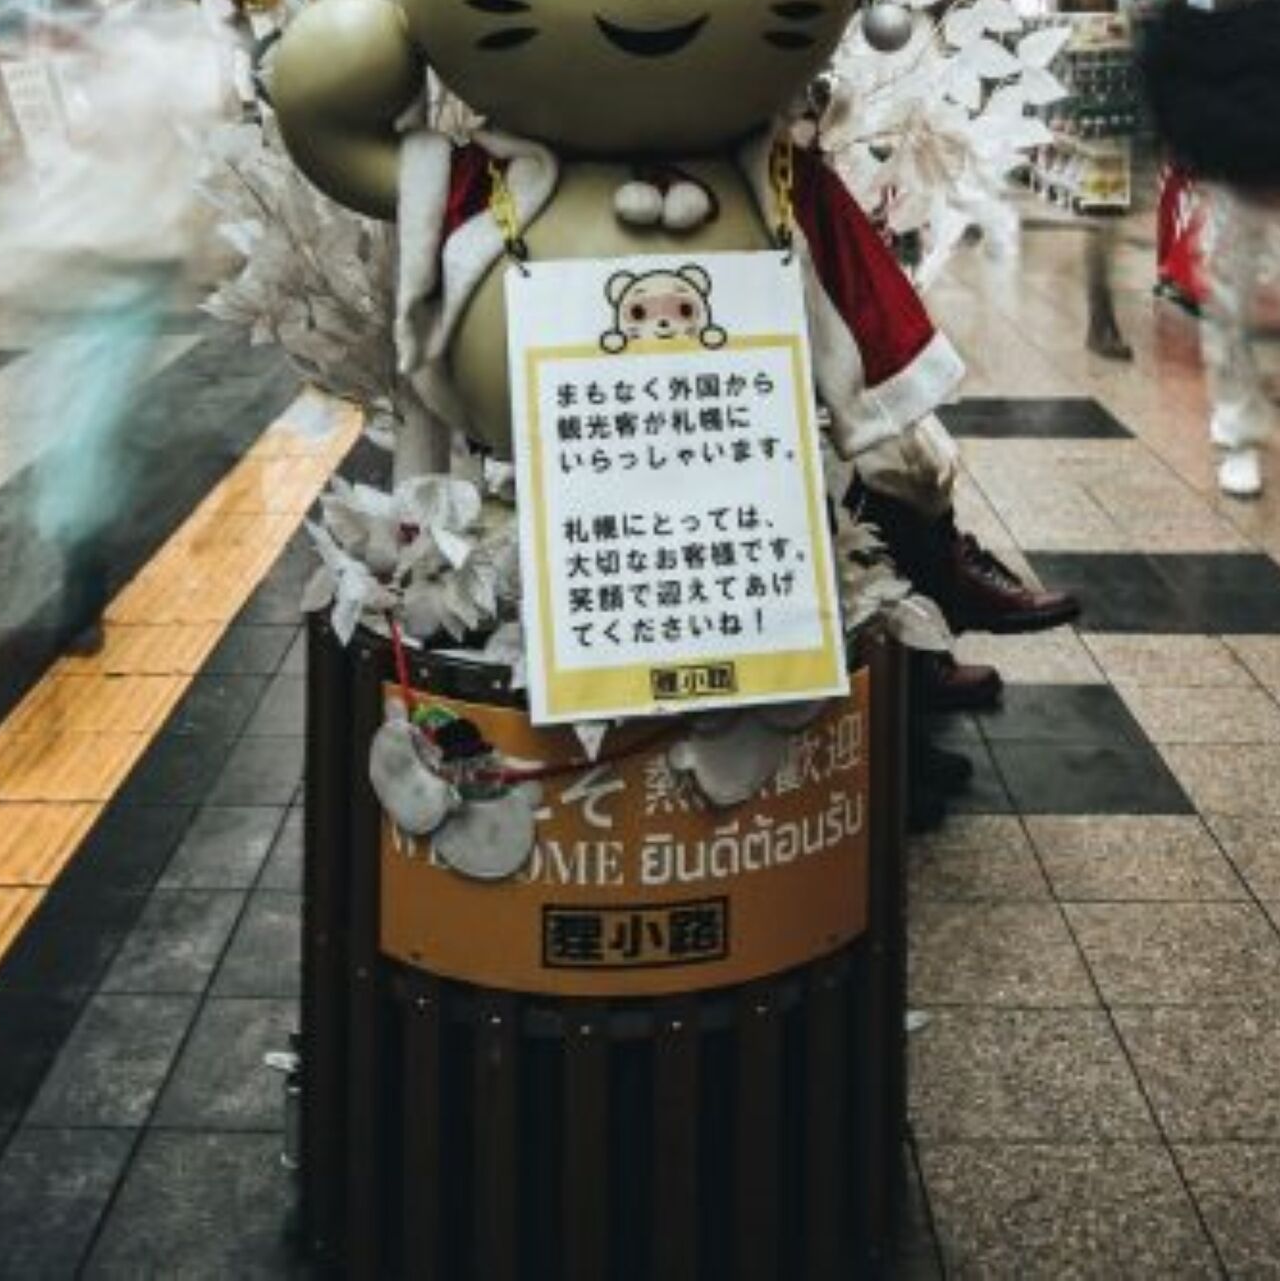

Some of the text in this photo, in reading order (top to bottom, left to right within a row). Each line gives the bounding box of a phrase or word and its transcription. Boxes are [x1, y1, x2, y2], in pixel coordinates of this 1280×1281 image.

[557, 371, 775, 407] まもなく外国から
[557, 405, 751, 441] 観光客が札幌に
[559, 437, 795, 475] いらっしゃいます。
[563, 504, 774, 544] 札幌にとっては、
[567, 537, 805, 578] 大切なお客様です。
[569, 571, 795, 613] 笑顔で迎えてあげ
